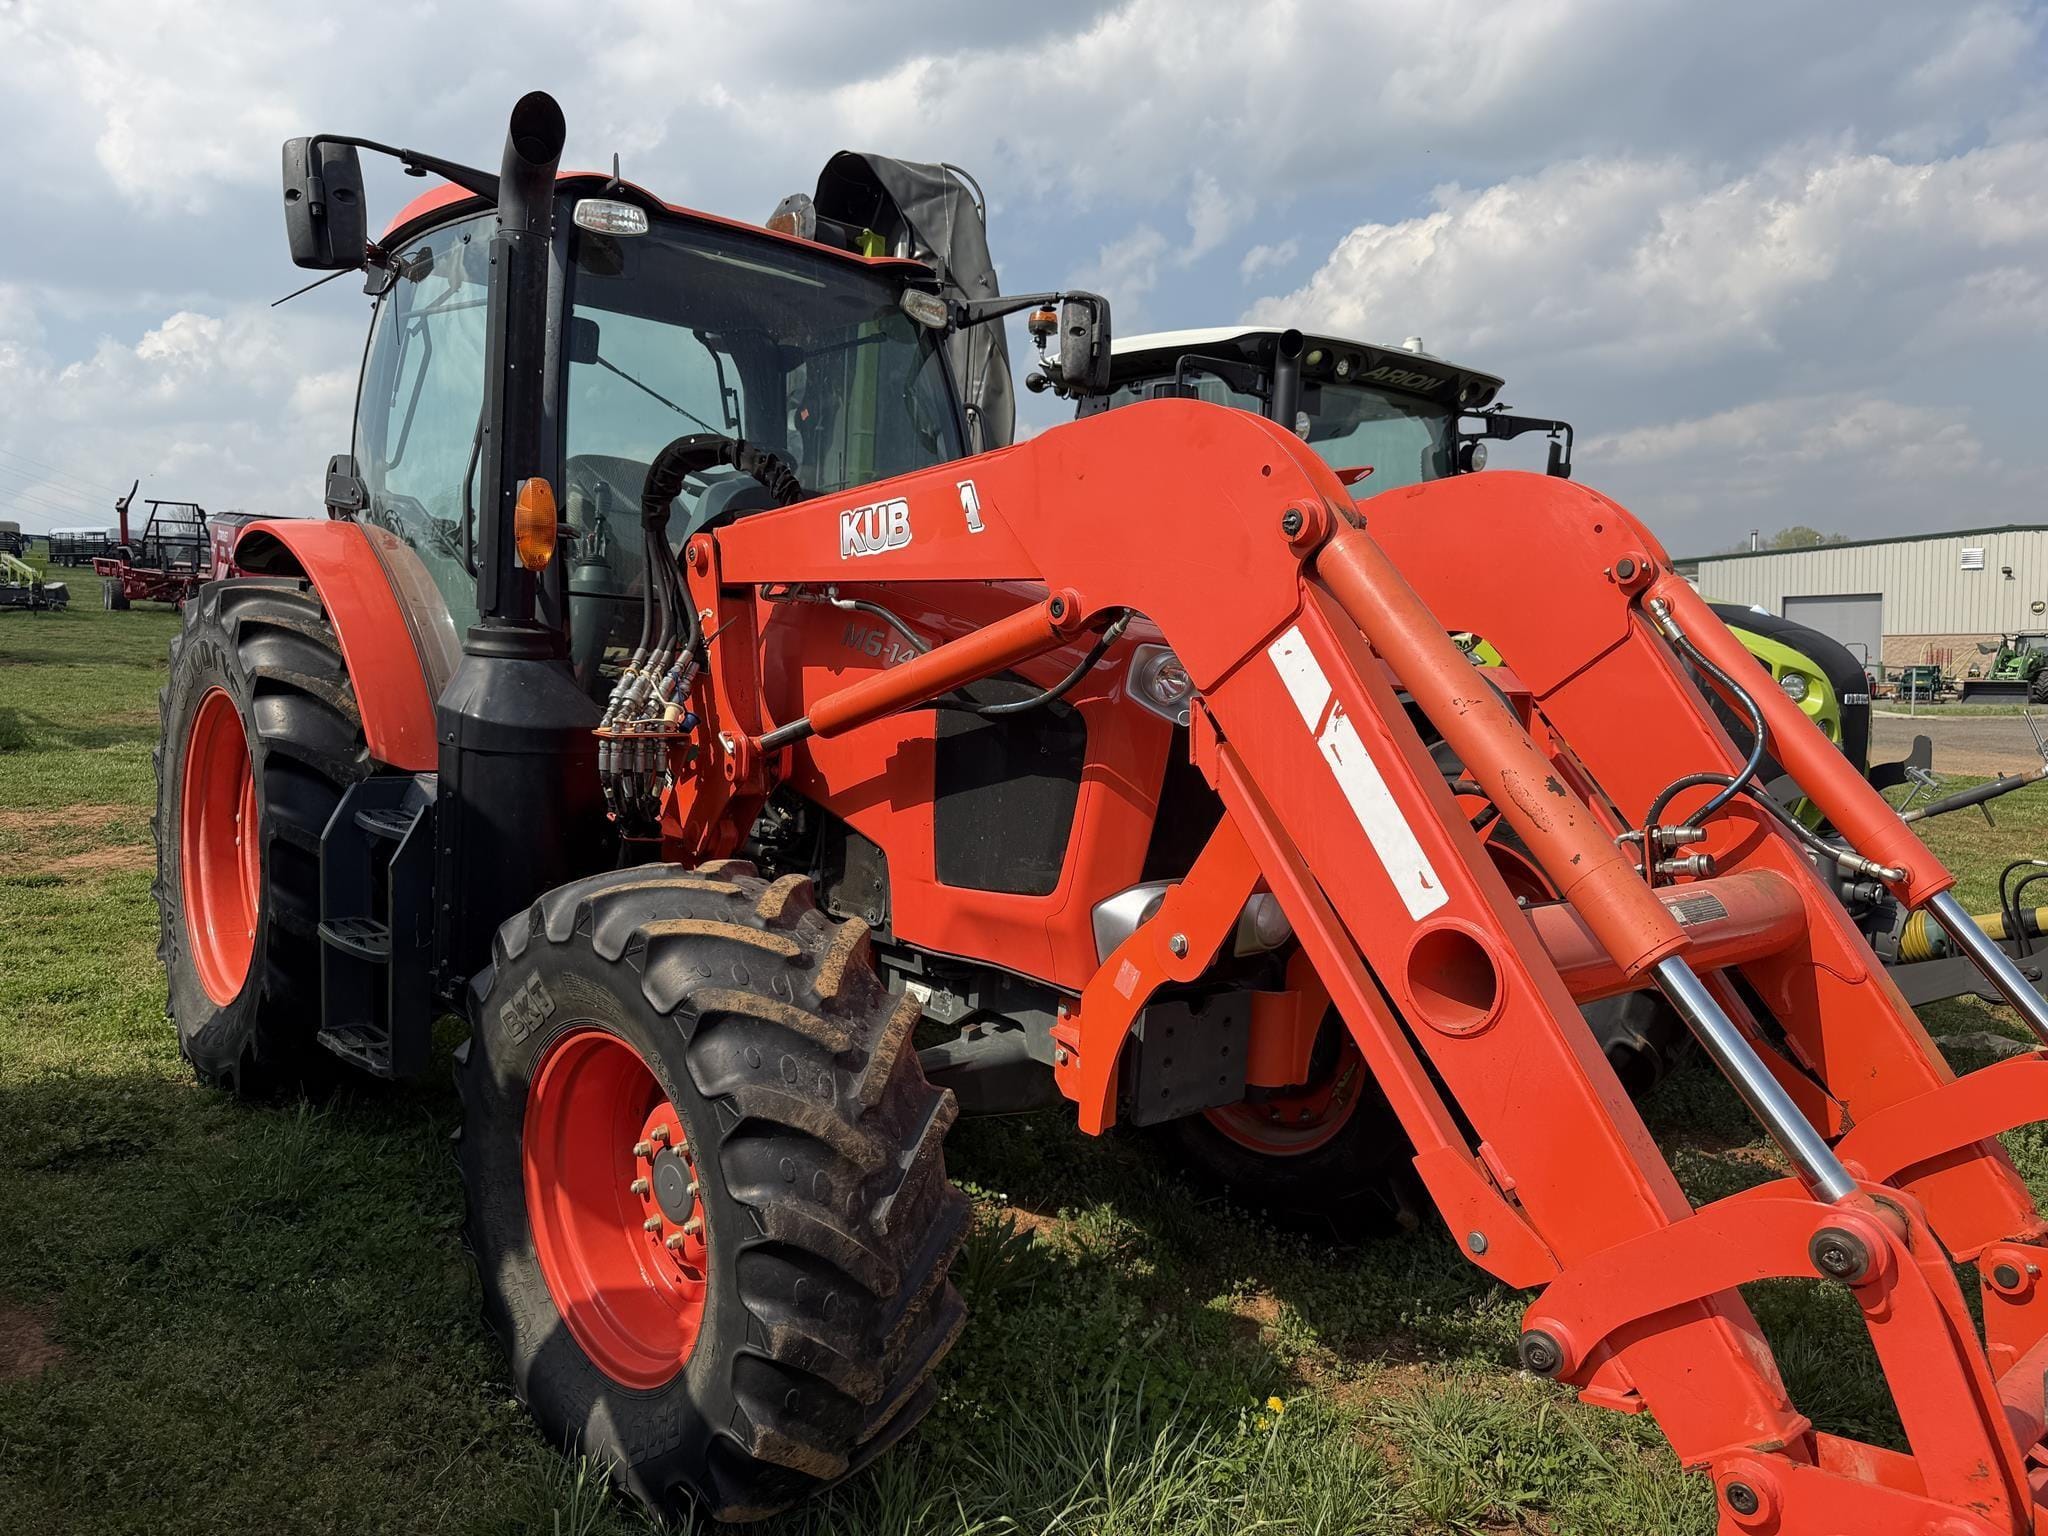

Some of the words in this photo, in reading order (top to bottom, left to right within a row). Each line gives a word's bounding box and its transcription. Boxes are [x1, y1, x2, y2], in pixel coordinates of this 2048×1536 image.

[1361, 366, 1446, 391] ARION
[841, 621, 919, 664] M6-14
[500, 970, 556, 1046] BKT
